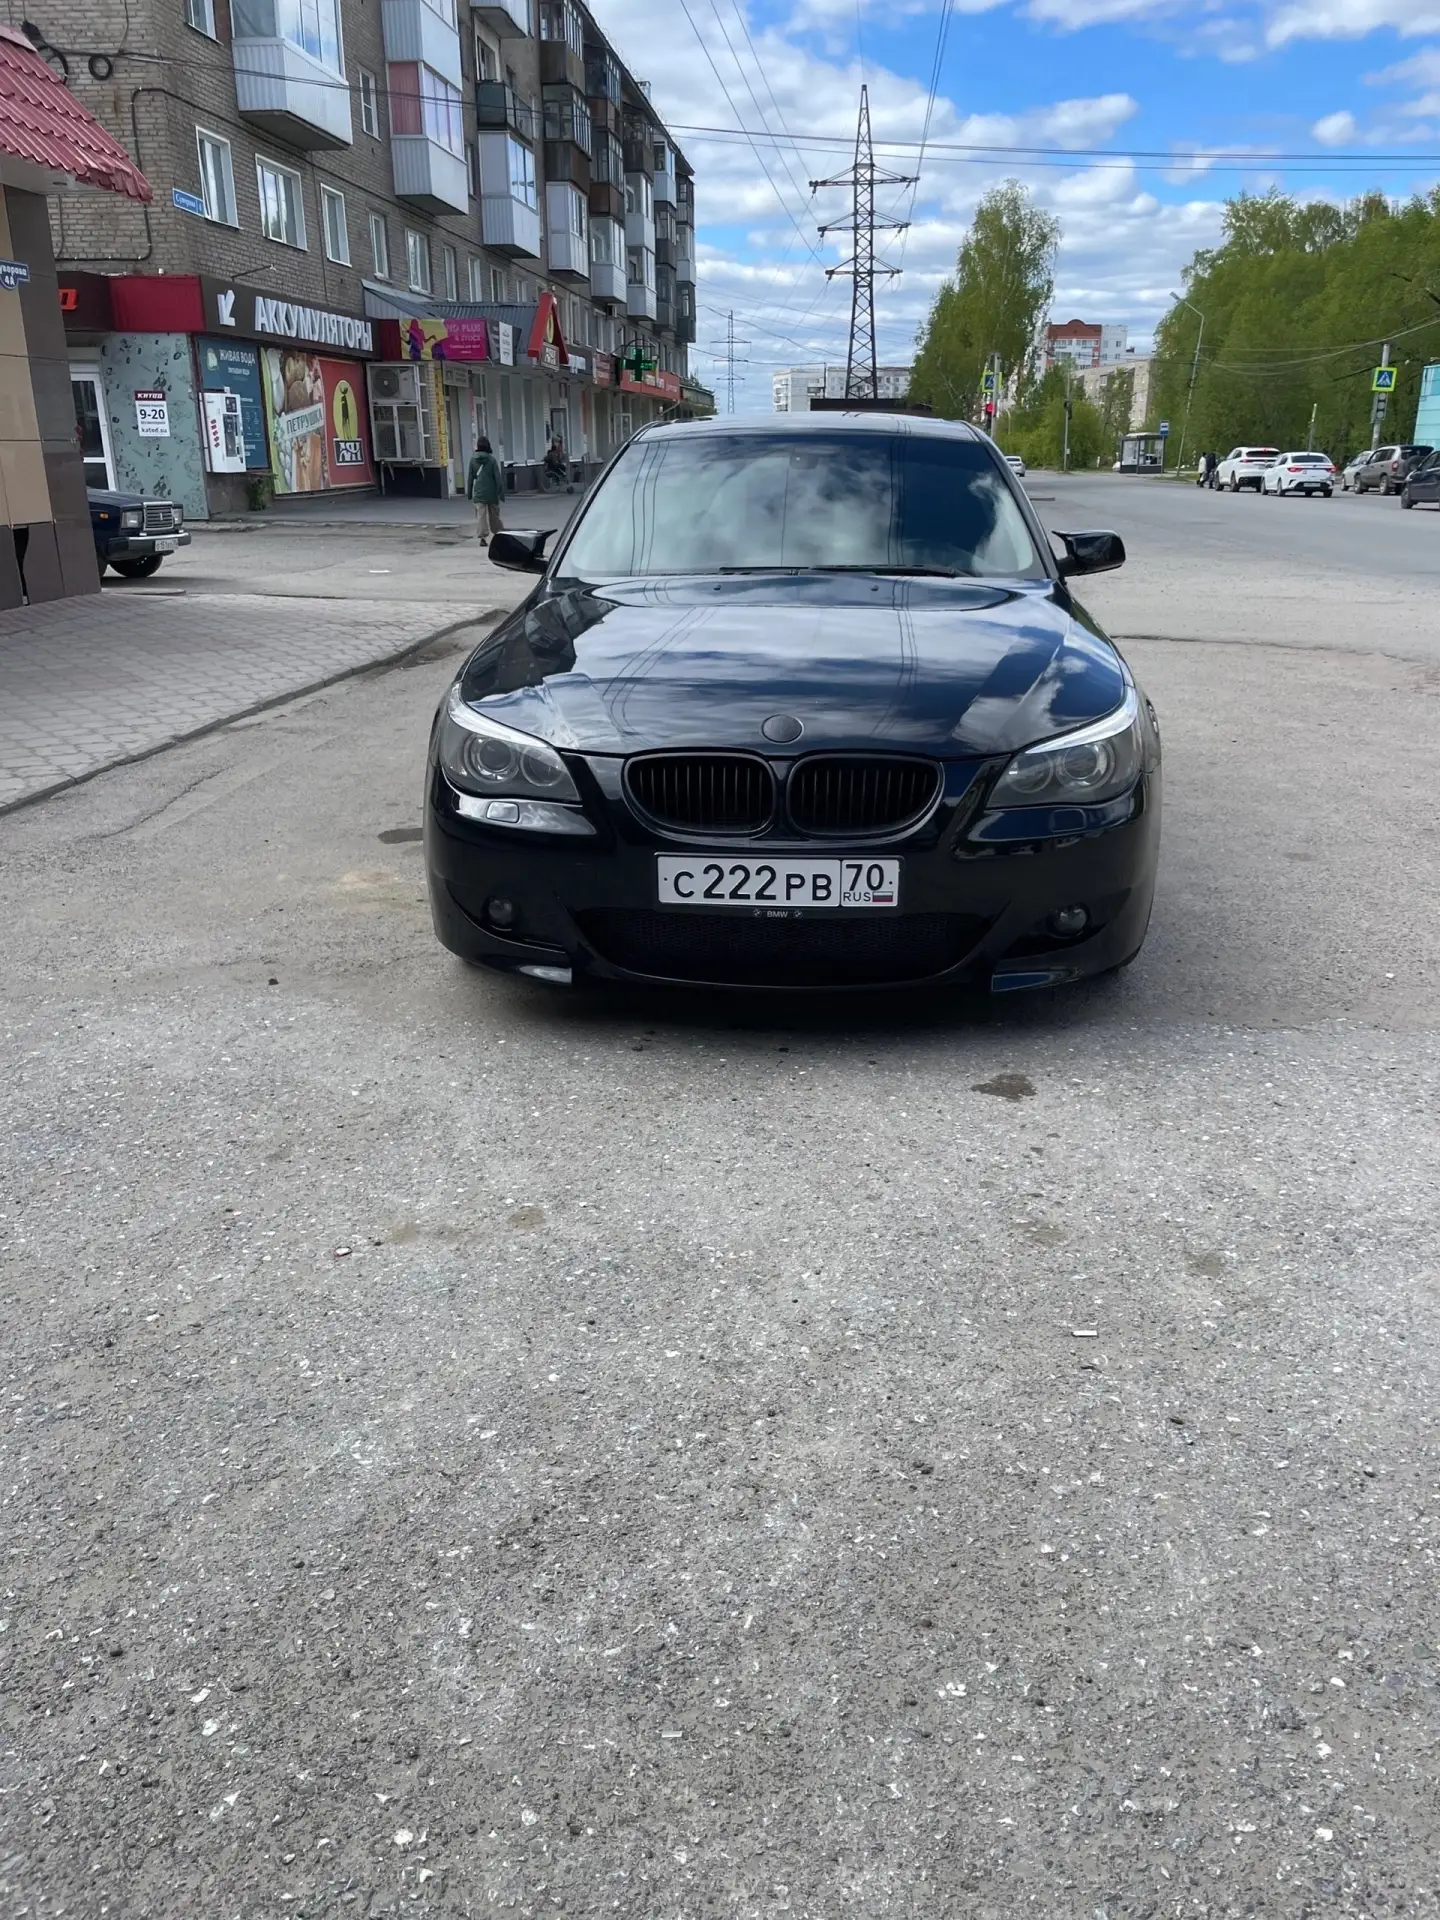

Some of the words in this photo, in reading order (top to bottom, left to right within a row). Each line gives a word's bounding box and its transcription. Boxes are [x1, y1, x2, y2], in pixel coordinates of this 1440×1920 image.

[254, 296, 374, 352] АККУМУЛЯТОРЫ
[241, 351, 256, 367] ВОДА
[139, 409, 166, 420] 9-20
[286, 407, 323, 434] ПЕТРУШКА
[845, 864, 885, 891] 70
[843, 891, 872, 902] RUS
[766, 910, 789, 918] BMW
